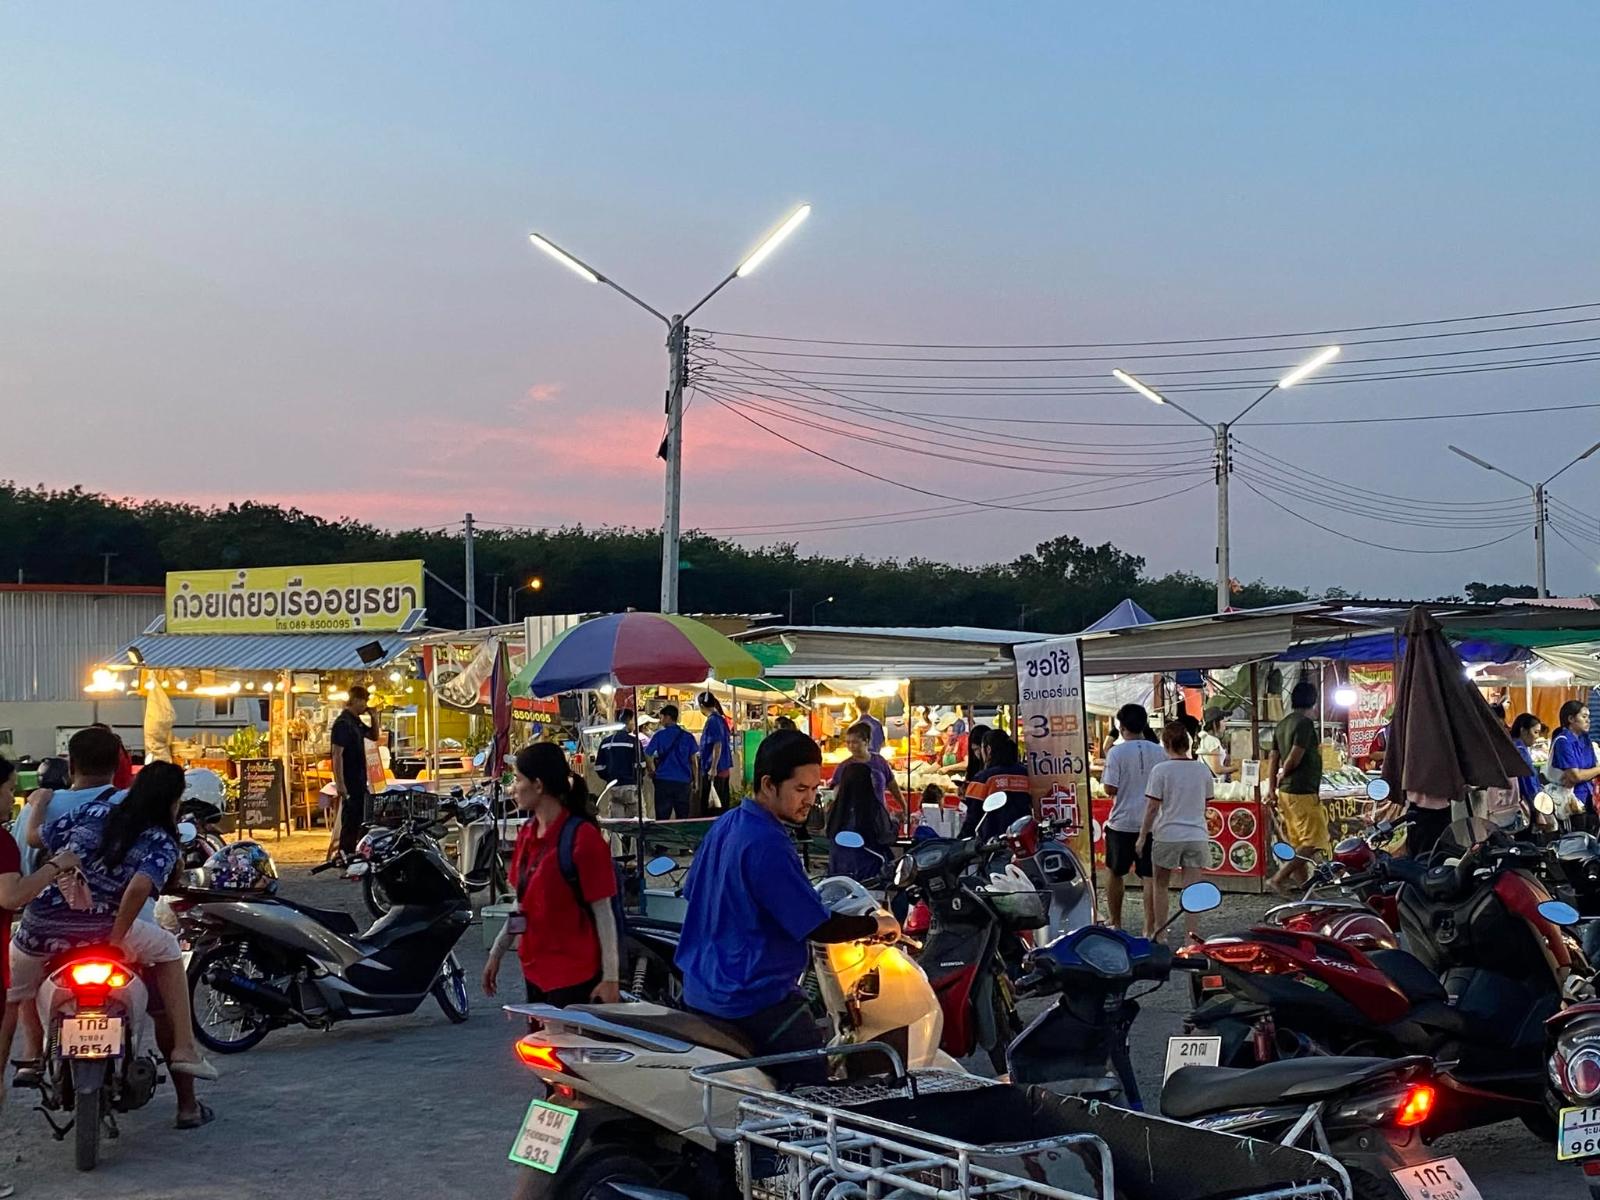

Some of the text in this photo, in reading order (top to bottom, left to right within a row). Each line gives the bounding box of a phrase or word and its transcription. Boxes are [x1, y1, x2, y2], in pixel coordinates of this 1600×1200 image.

[173, 571, 417, 626] ก๋วยเตี๋ยวเรืออยุธยา
[1026, 649, 1070, 677] ขอใช้
[1029, 715, 1078, 738] 3BB
[1030, 750, 1083, 775] ได้แล้ว
[69, 1044, 113, 1055] 8654
[1571, 1138, 1600, 1154] 96
[1413, 1164, 1452, 1188] 1กร
